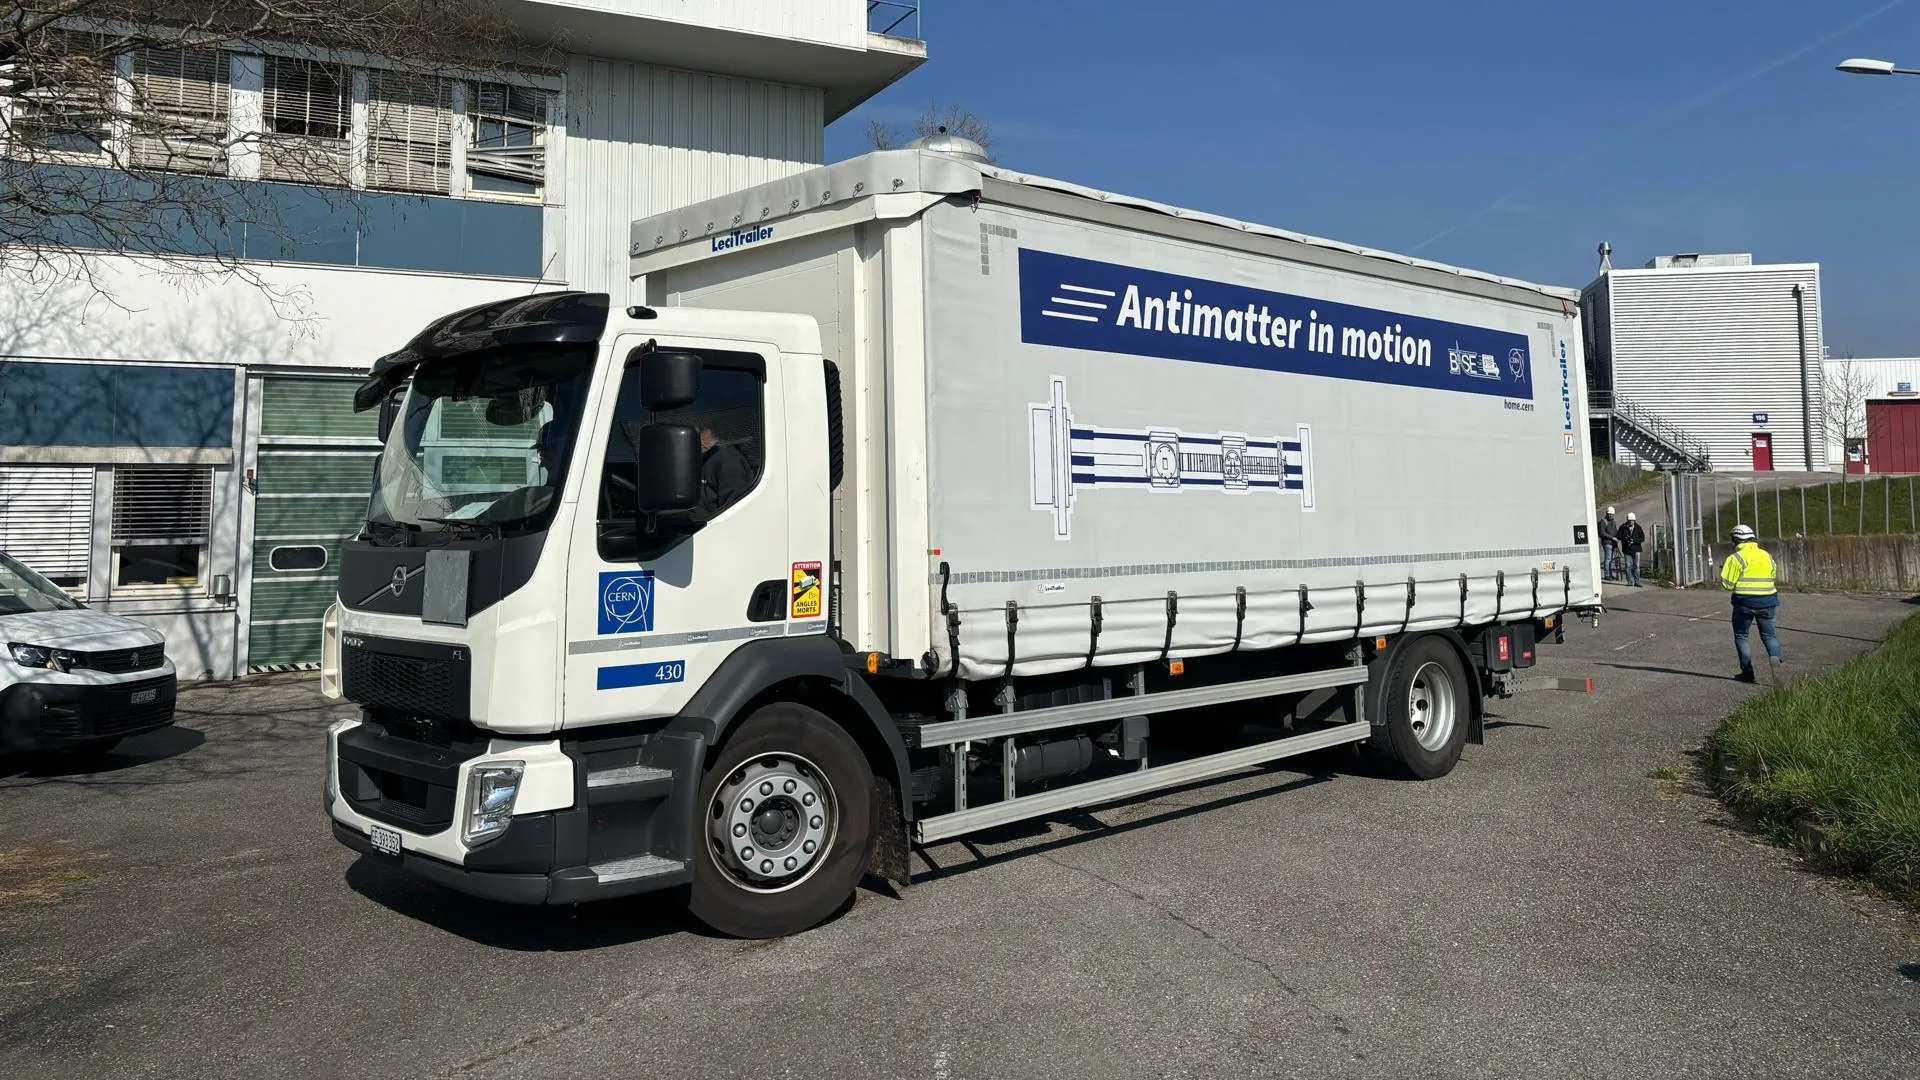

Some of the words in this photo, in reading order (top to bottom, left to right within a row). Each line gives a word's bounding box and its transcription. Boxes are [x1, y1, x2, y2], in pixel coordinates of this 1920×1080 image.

[711, 225, 773, 252] LeciTrailer
[1115, 284, 1302, 349] Antimatter
[1308, 309, 1334, 354] in
[1341, 323, 1432, 367] motion
[1560, 340, 1572, 430] LeciTrailer
[1504, 399, 1534, 411] home.cern
[608, 592, 636, 602] CERN
[655, 664, 682, 680] 430
